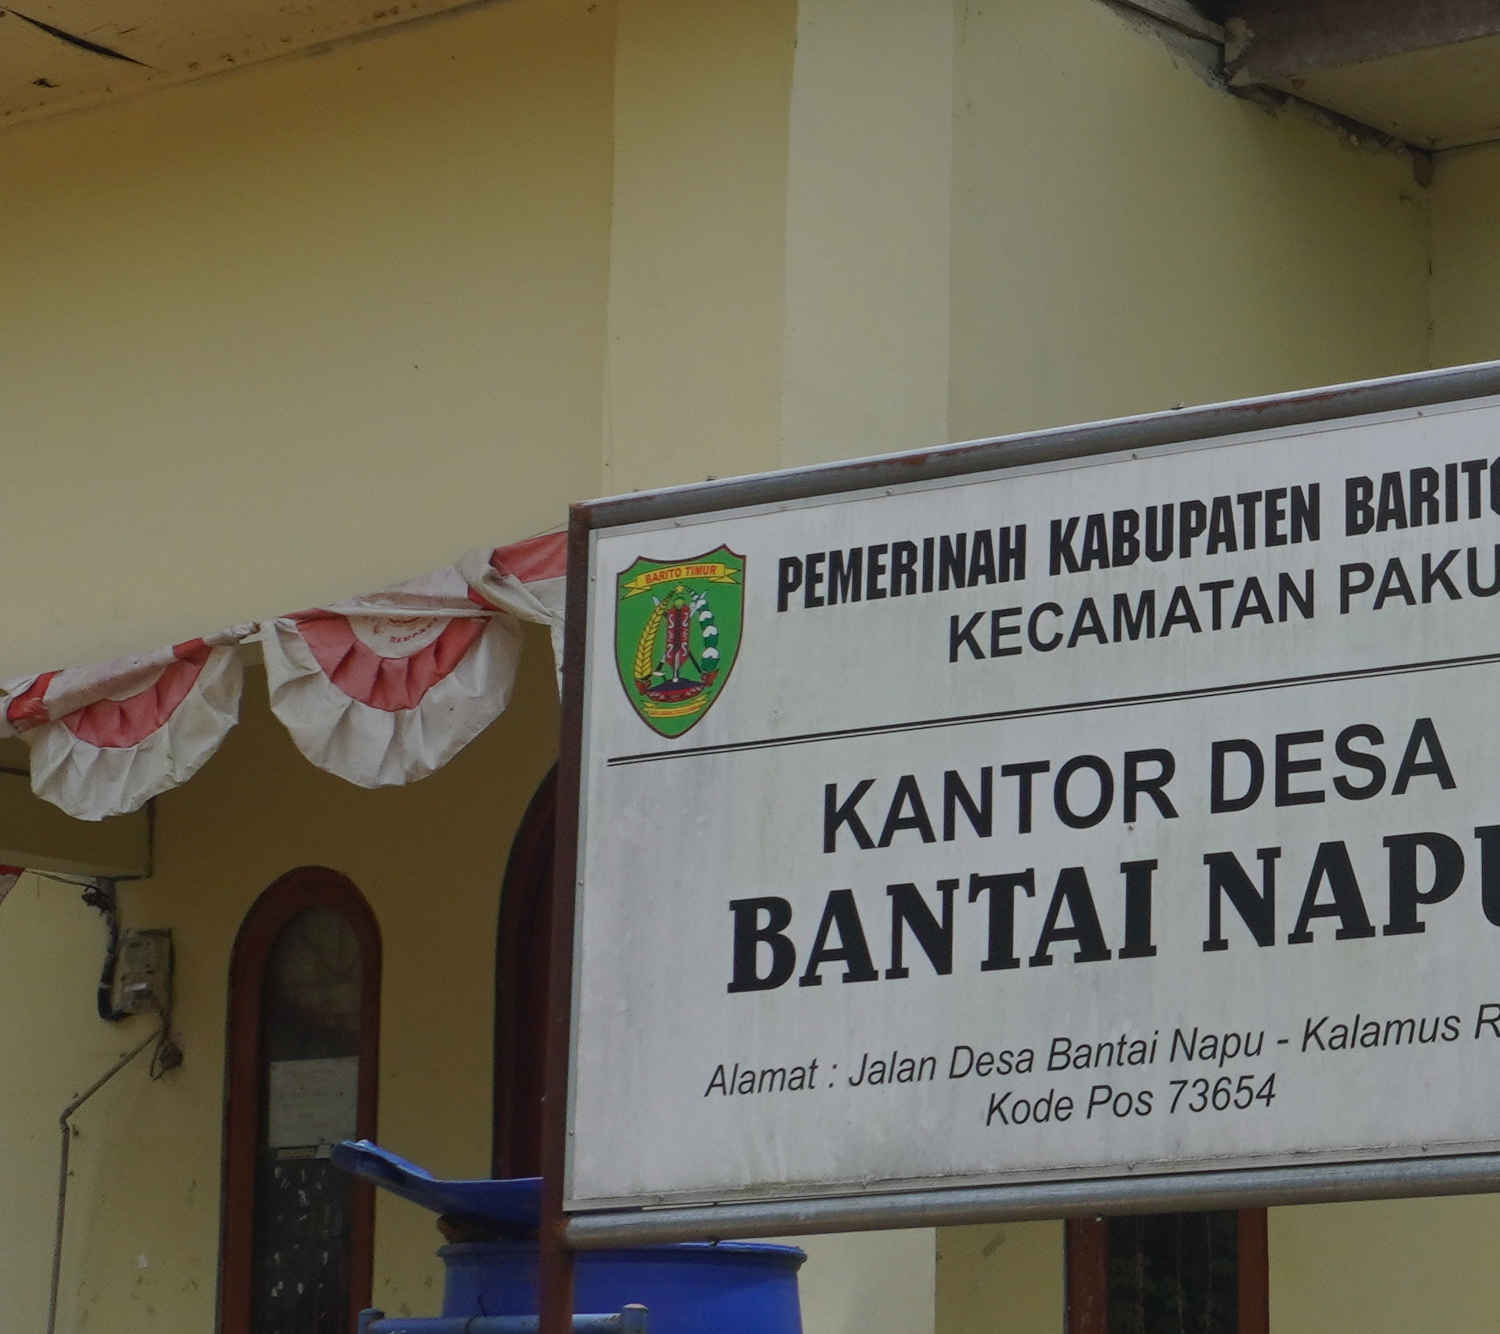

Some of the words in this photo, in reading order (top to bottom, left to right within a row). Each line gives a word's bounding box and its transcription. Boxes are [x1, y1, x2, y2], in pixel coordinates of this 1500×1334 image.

[645, 568, 682, 584] BARITO
[684, 565, 717, 576] TIMUR
[776, 524, 1027, 612] PEMERINAH
[1048, 482, 1321, 577] KABUPATEN
[948, 568, 1316, 664] KECAMATAN
[823, 748, 1180, 854] KANTOR
[1210, 717, 1458, 815] DESA
[726, 858, 1159, 994] BANTAI
[703, 1057, 819, 1098] Alamat
[848, 1050, 937, 1087] Jalan
[948, 1045, 1035, 1080] Desa
[1046, 1029, 1159, 1072] Bantai
[1169, 1026, 1265, 1069] Napu
[1301, 1013, 1461, 1053] Kalamus
[985, 1088, 1074, 1127] Kode
[1086, 1084, 1154, 1120] Pos
[1169, 1072, 1276, 1114] 73654
